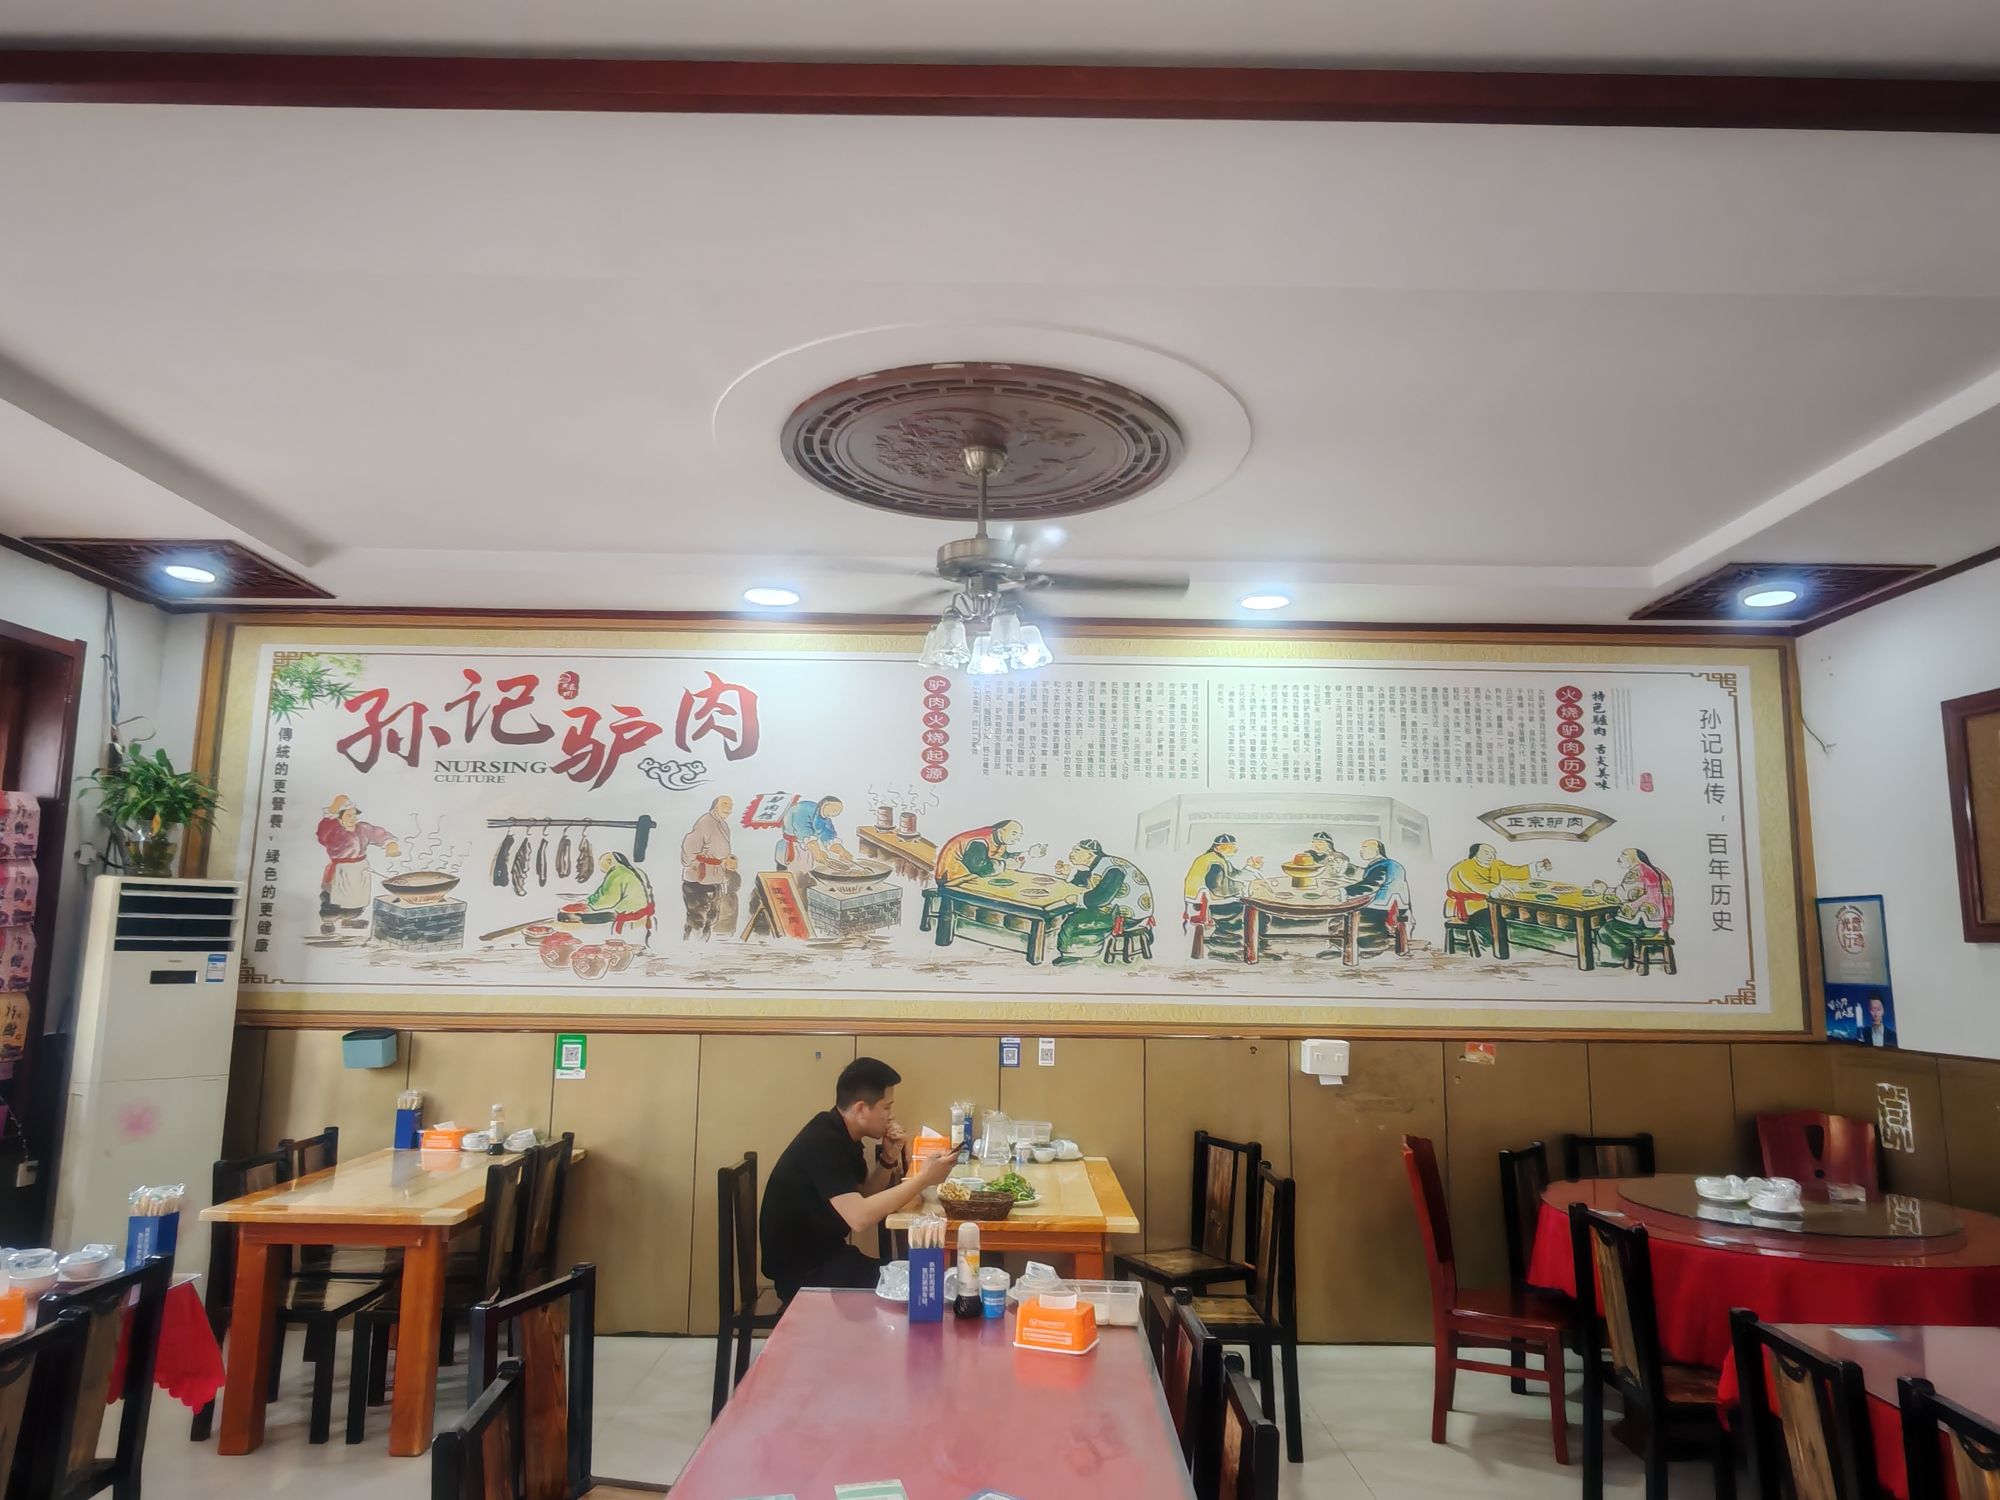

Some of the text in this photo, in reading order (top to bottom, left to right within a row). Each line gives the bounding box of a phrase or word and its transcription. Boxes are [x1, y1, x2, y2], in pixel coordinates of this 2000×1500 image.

[336, 668, 760, 791] 孙记驴肉
[926, 678, 948, 781] 驴肉火烧起源
[1559, 687, 1584, 791] 火烧驴肉历史
[433, 775, 506, 784] CULTURE
[434, 759, 548, 775] NURSING
[1506, 815, 1584, 829] 正宗驴肉
